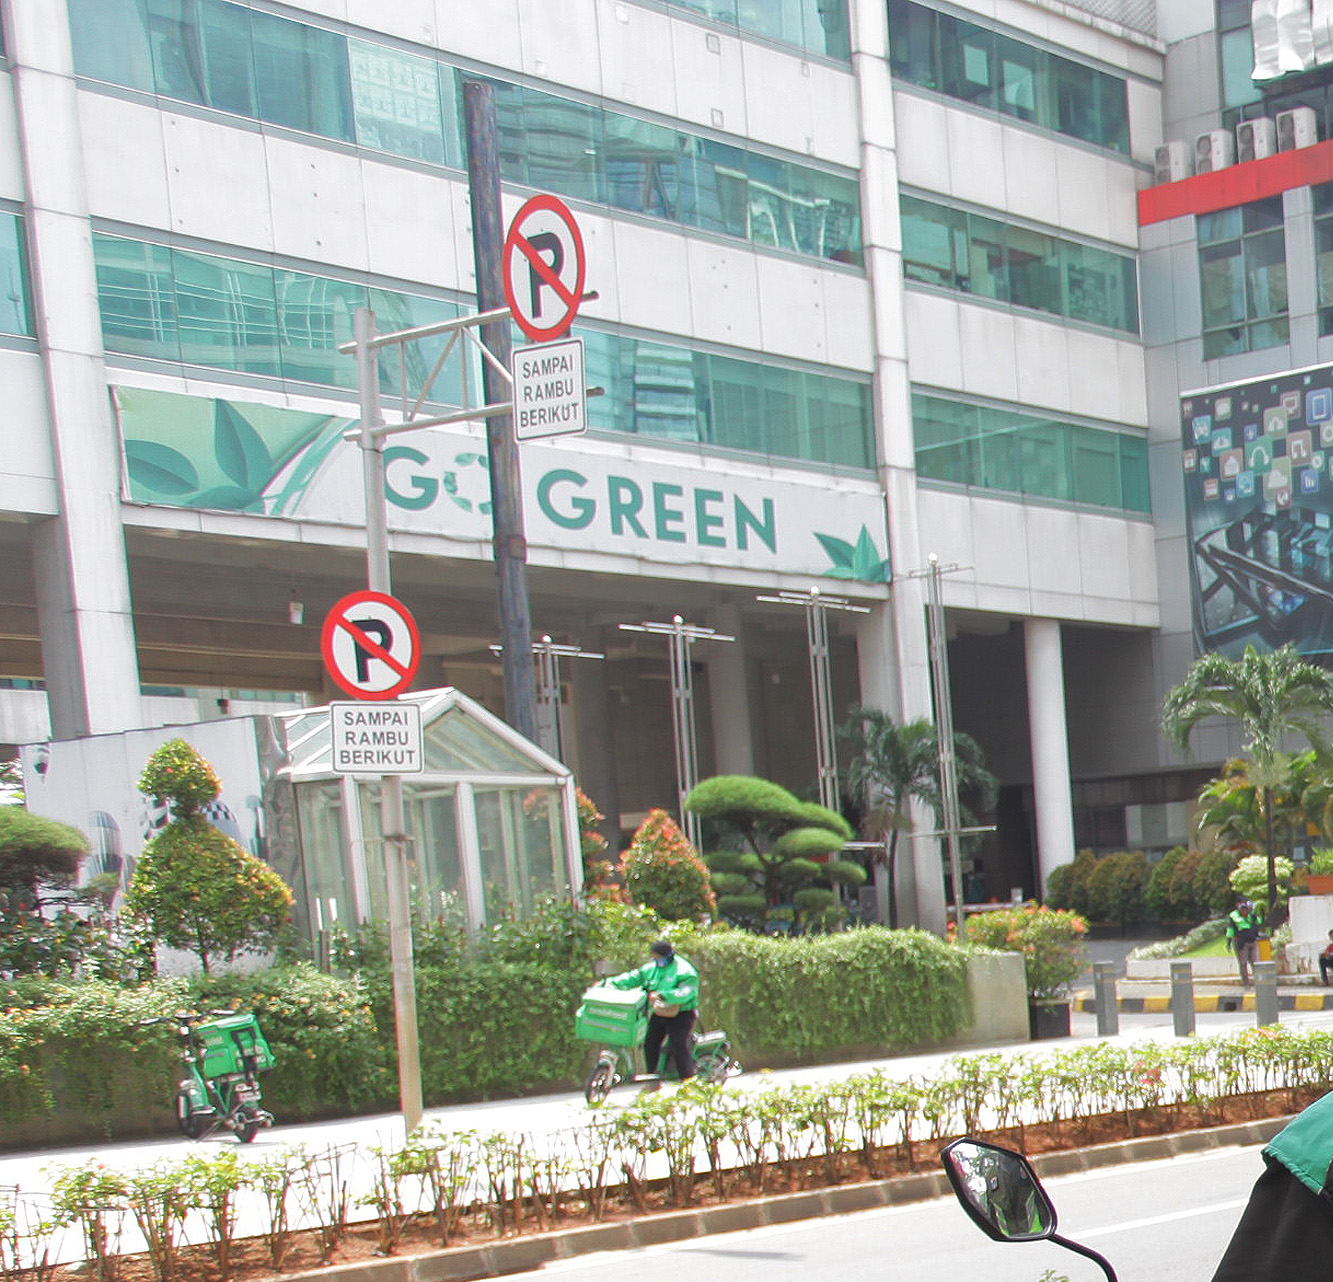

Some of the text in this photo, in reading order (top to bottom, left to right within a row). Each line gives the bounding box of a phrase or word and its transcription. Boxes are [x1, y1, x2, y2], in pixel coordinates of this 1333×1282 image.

[522, 354, 573, 379] SAMPAI
[523, 378, 574, 402] RAMBU
[520, 402, 579, 428] BERIKUT
[537, 468, 777, 555] GREEN
[344, 711, 408, 727] SAMPAI
[345, 731, 409, 746] RAMBU
[340, 750, 415, 765] BERIKUT
